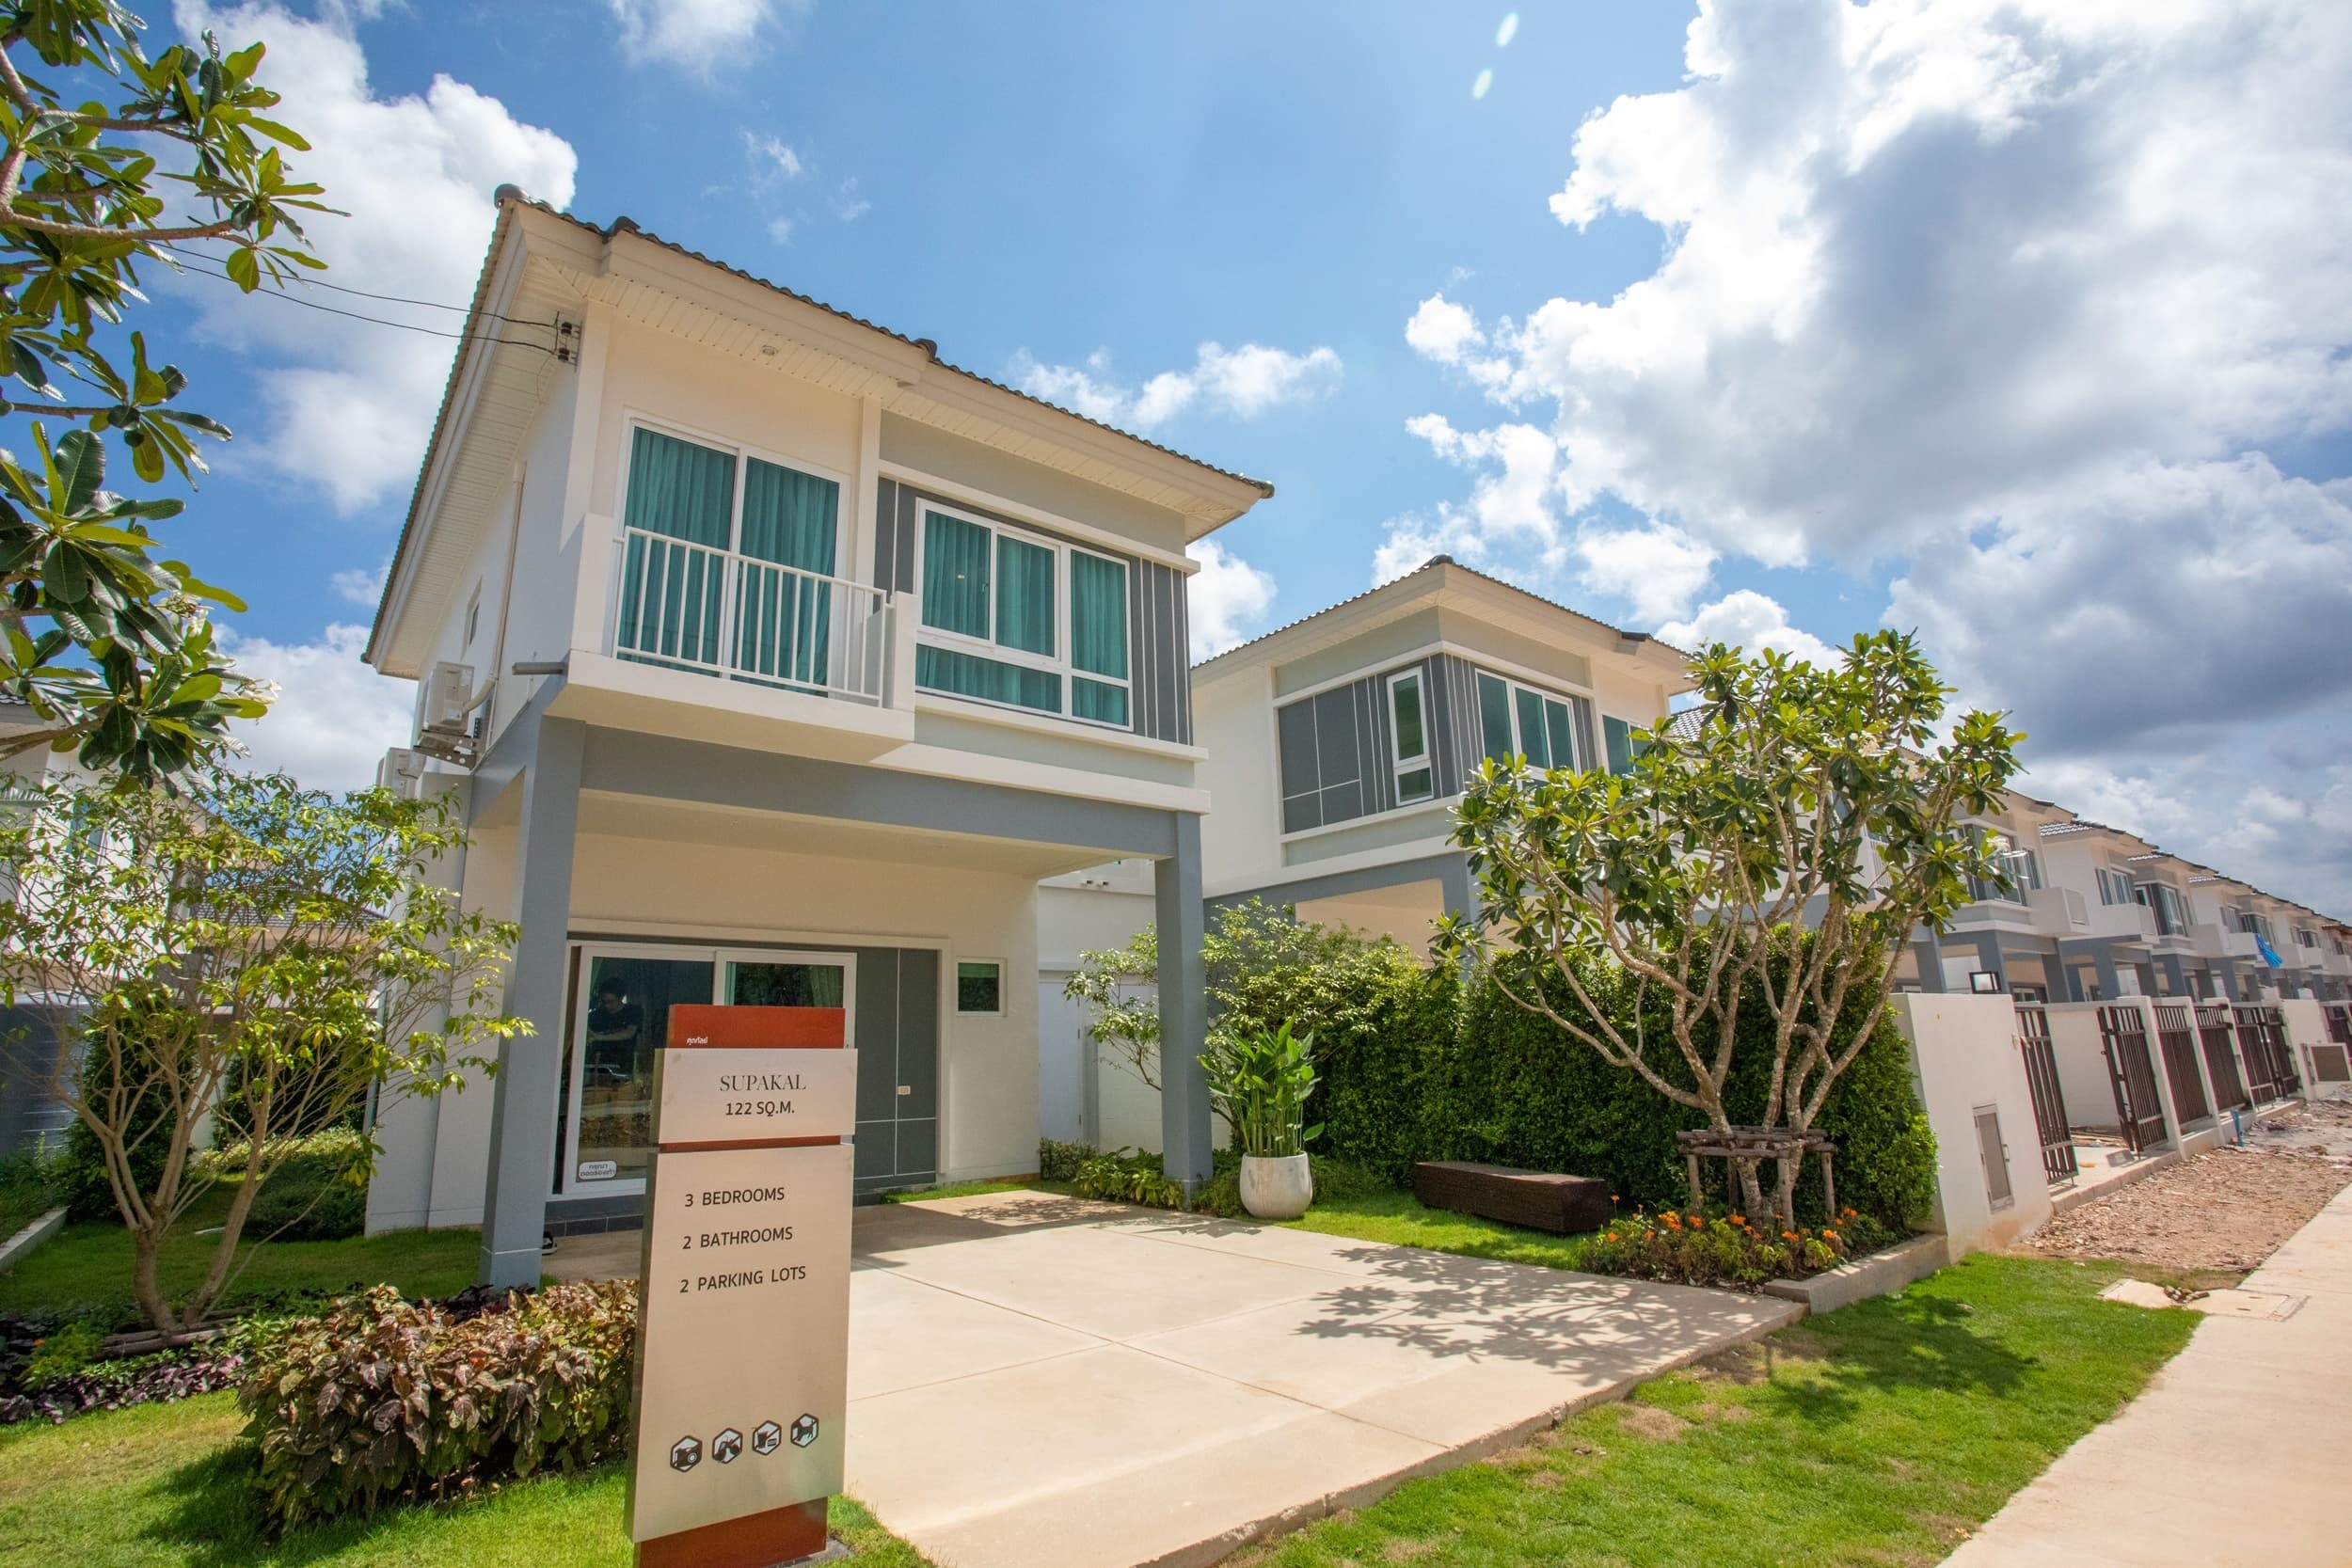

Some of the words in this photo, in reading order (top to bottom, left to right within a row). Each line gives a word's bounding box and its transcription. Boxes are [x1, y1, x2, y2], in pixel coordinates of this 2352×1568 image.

[720, 1074, 806, 1092] SUPAKAL
[725, 1102, 753, 1116] 122
[756, 1101, 796, 1117] SQ.M.
[684, 1194, 694, 1208] 3
[702, 1187, 786, 1207] BEDROOMS
[682, 1235, 692, 1250] 2
[700, 1227, 793, 1248] BATHROOMS
[679, 1278, 690, 1293] 2
[698, 1271, 764, 1291] PARKING
[771, 1265, 806, 1283] LOTS
